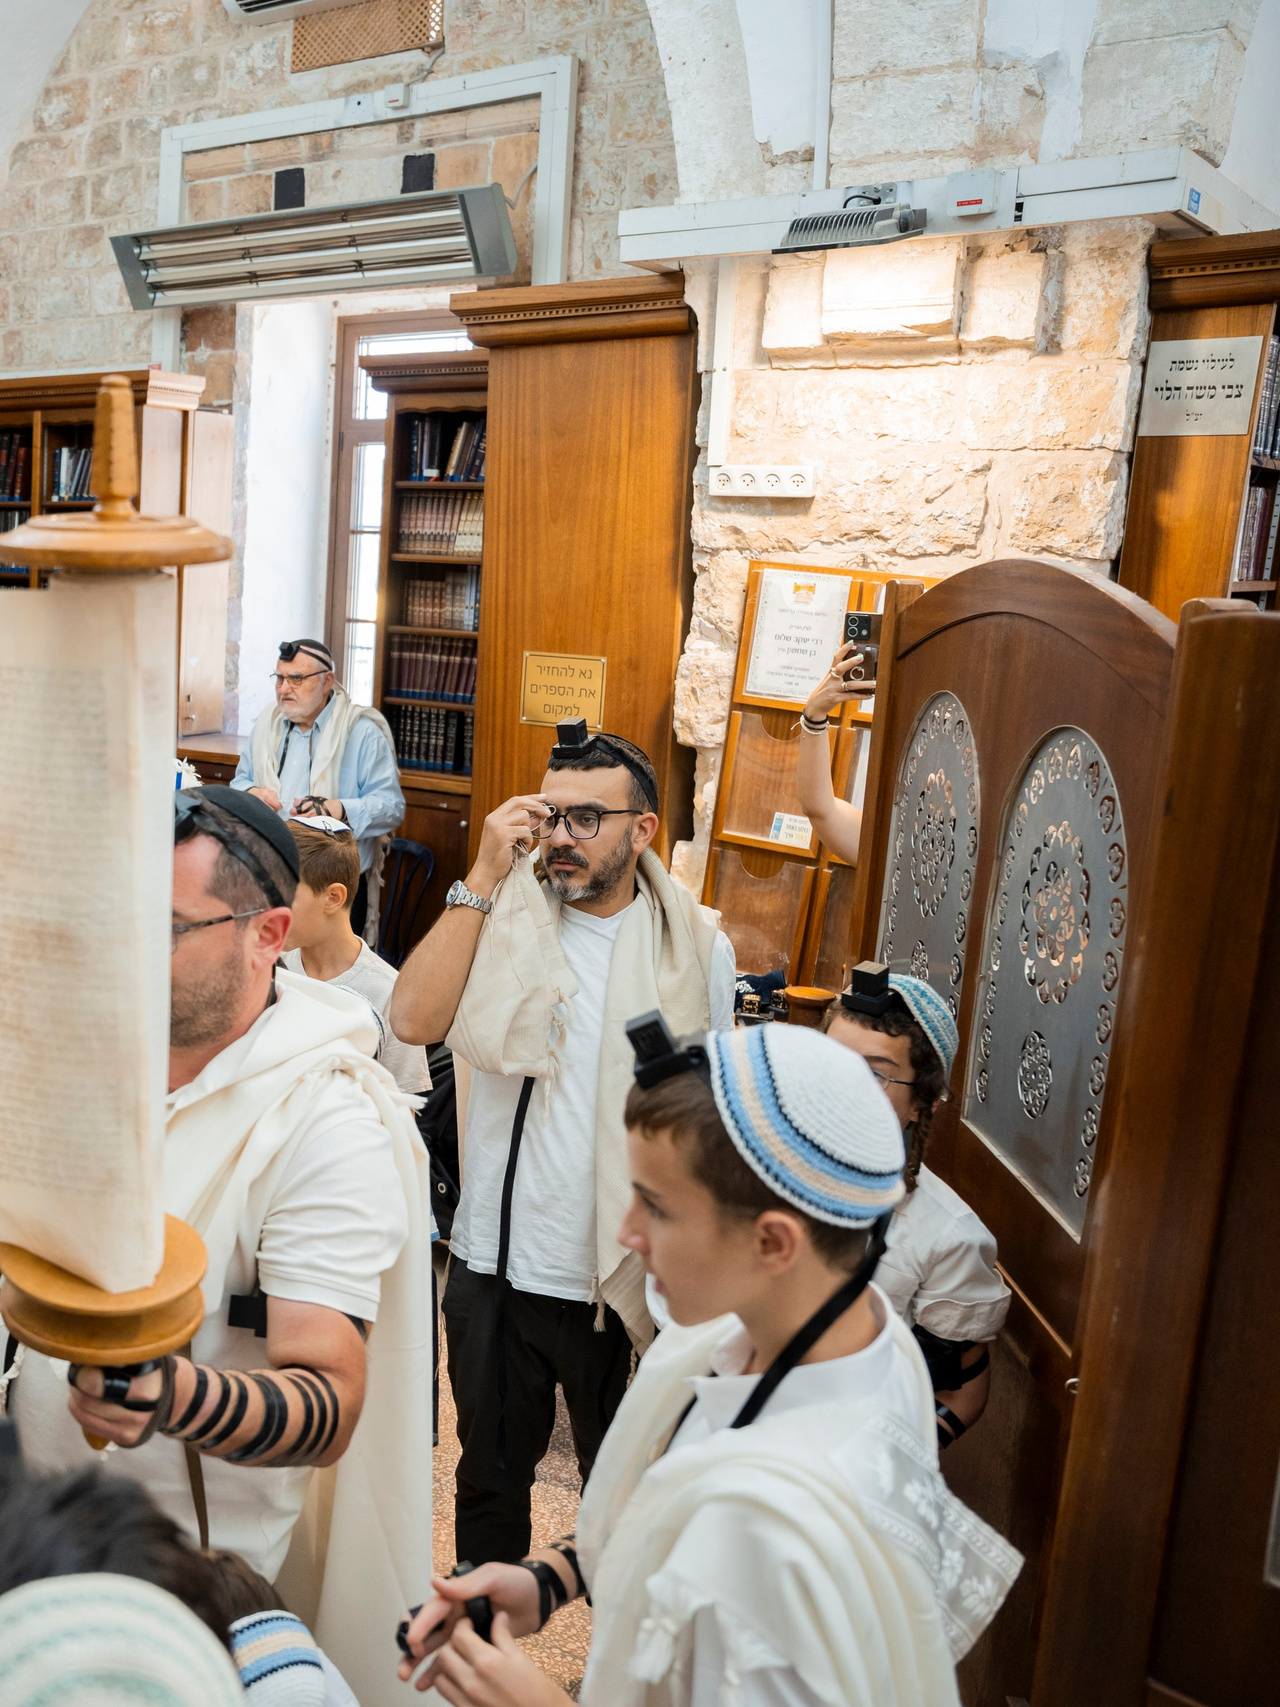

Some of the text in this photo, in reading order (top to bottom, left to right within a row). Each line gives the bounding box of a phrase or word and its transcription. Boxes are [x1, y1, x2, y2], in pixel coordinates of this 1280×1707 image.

[1169, 352, 1235, 372] לעילוי נשמת
[1154, 379, 1244, 401] צבי משה הלוי
[774, 633, 792, 642] שלום
[793, 636, 810, 645] יעקב
[536, 664, 593, 680] נא להחזיר
[530, 683, 597, 699] את הספרים
[543, 703, 580, 718] למקום
